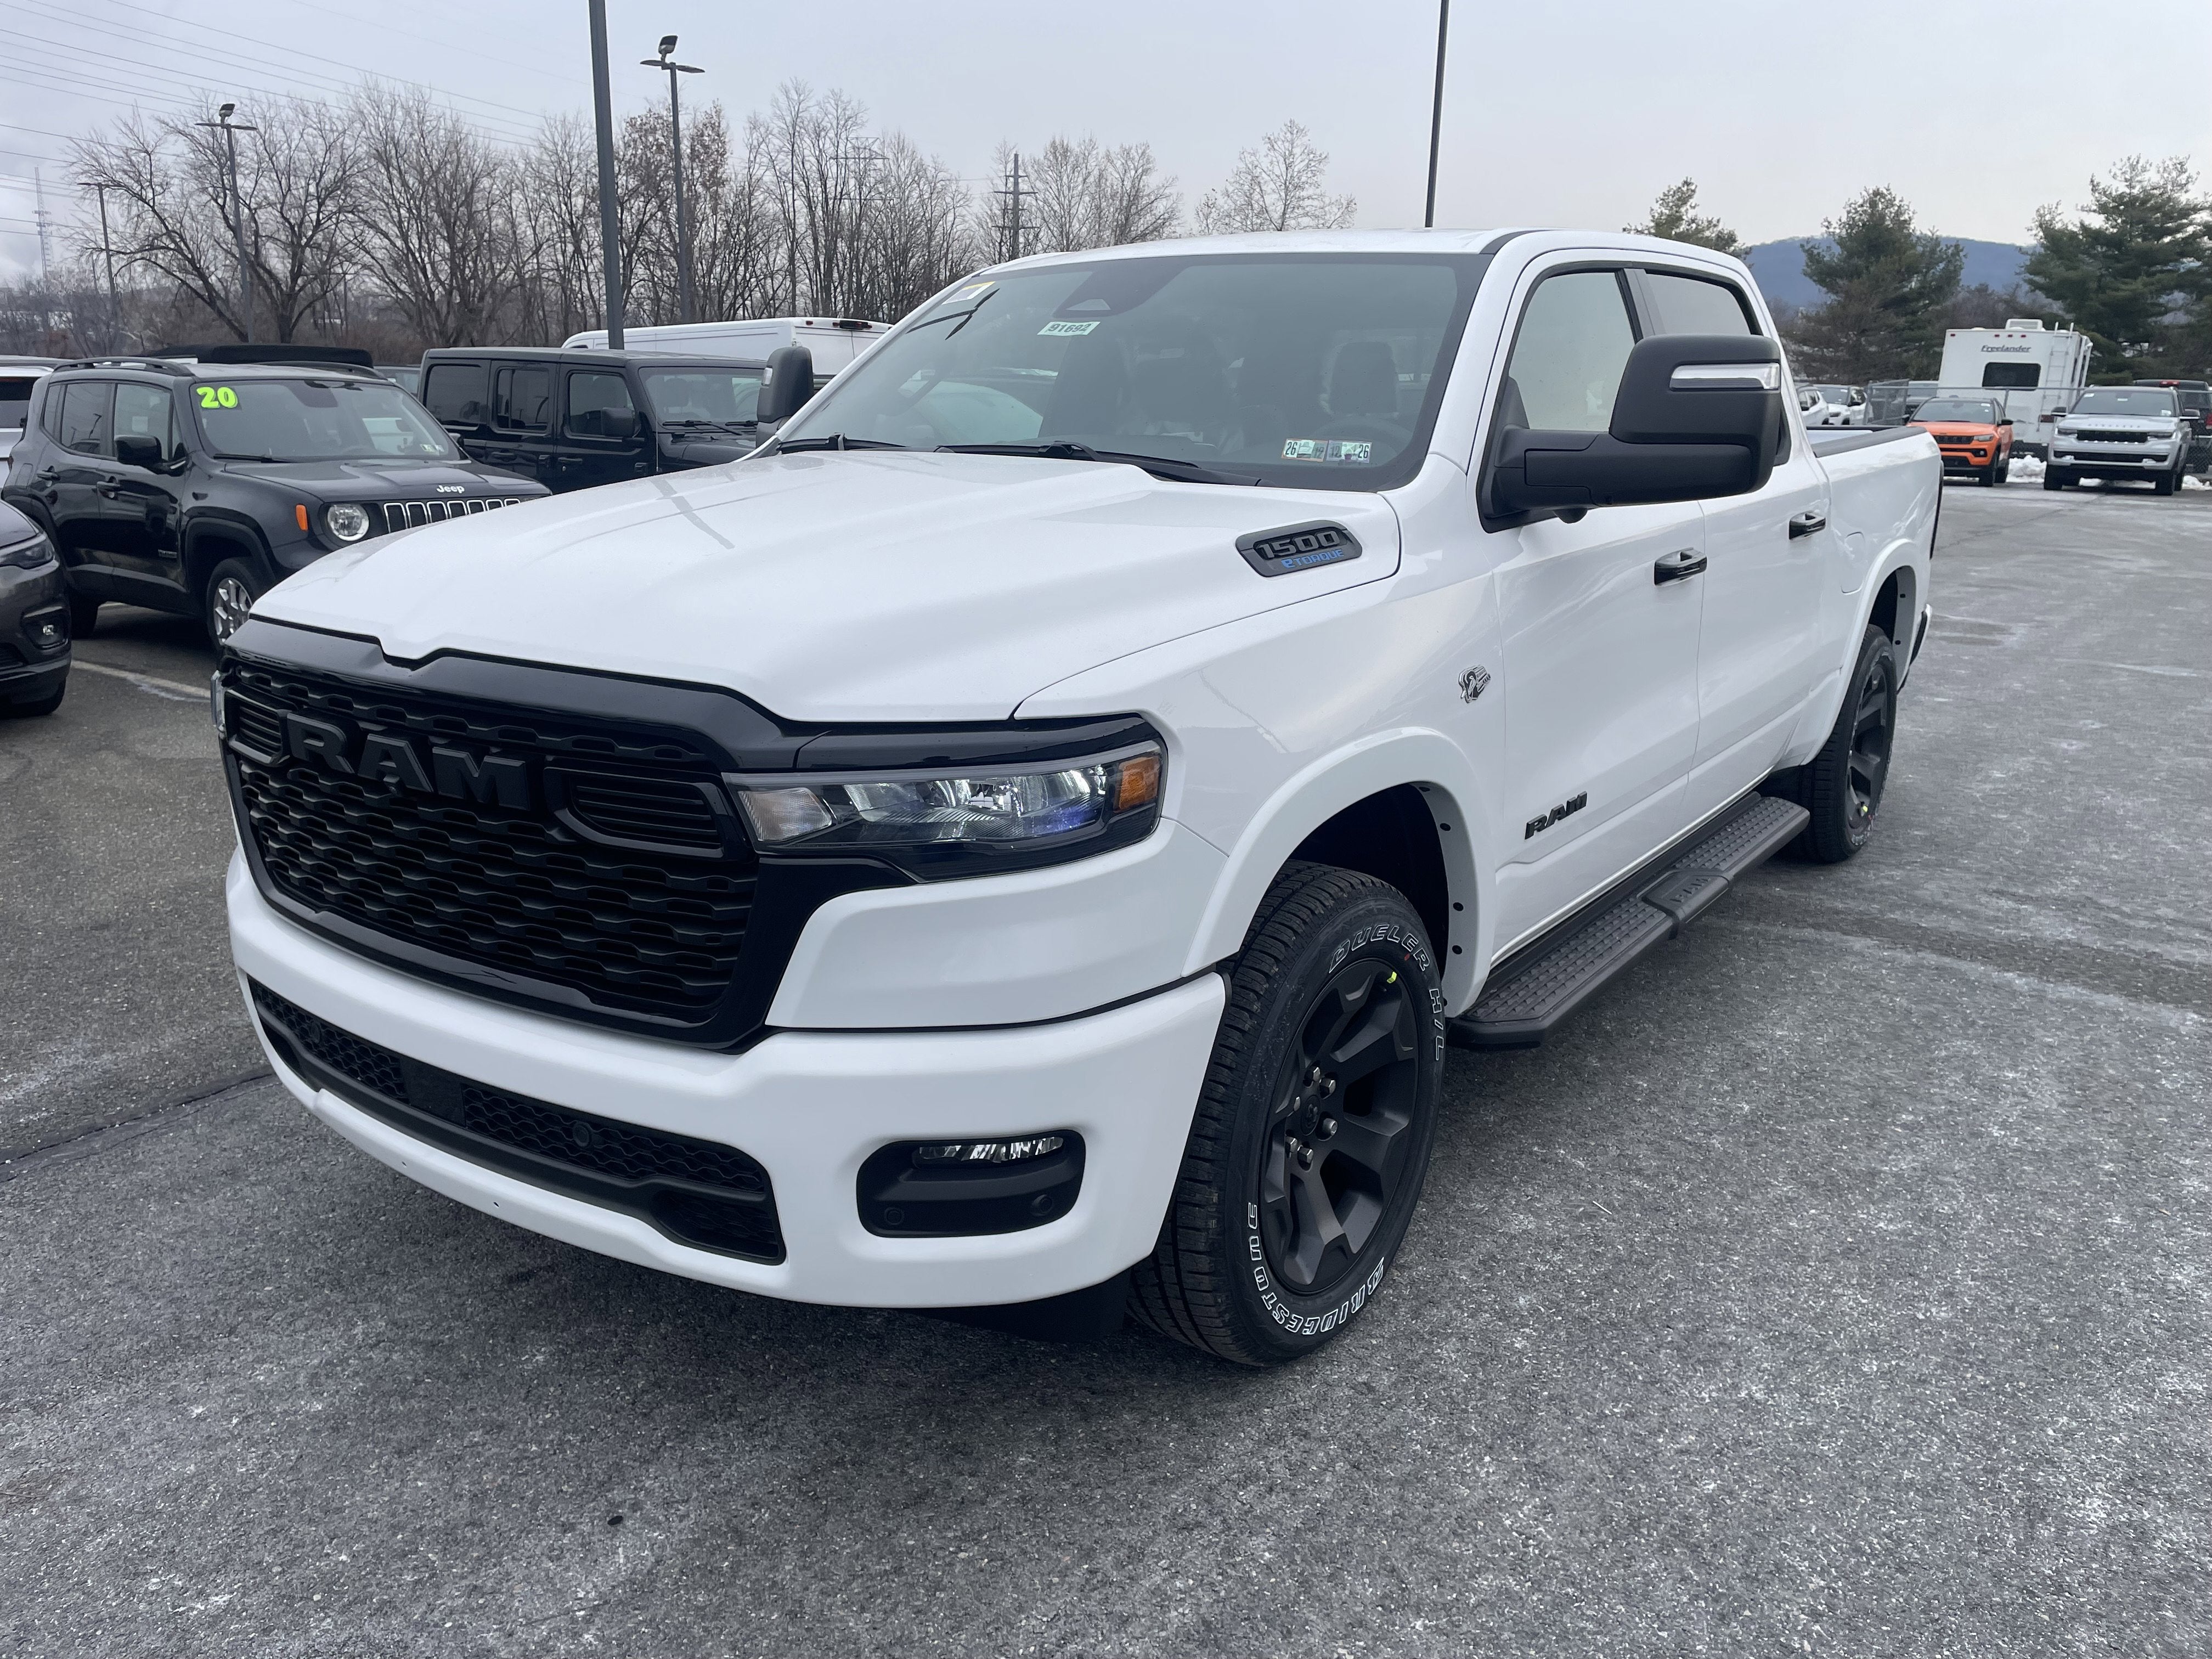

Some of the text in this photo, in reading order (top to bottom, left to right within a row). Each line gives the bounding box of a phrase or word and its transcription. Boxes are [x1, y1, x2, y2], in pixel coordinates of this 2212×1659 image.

[1048, 323, 1092, 332] 91692
[1980, 345, 2032, 353] Freelander
[196, 386, 238, 409] 20
[1285, 441, 1298, 456] 26
[1330, 444, 1369, 459] 12 26
[436, 485, 465, 494] Jeep
[1255, 531, 1341, 558] 1500
[287, 713, 531, 811] RAM
[1524, 791, 1588, 840] RAM
[1328, 923, 1444, 1061] DUELER H/L
[1247, 1201, 1385, 1335] BRIDGESTONE
